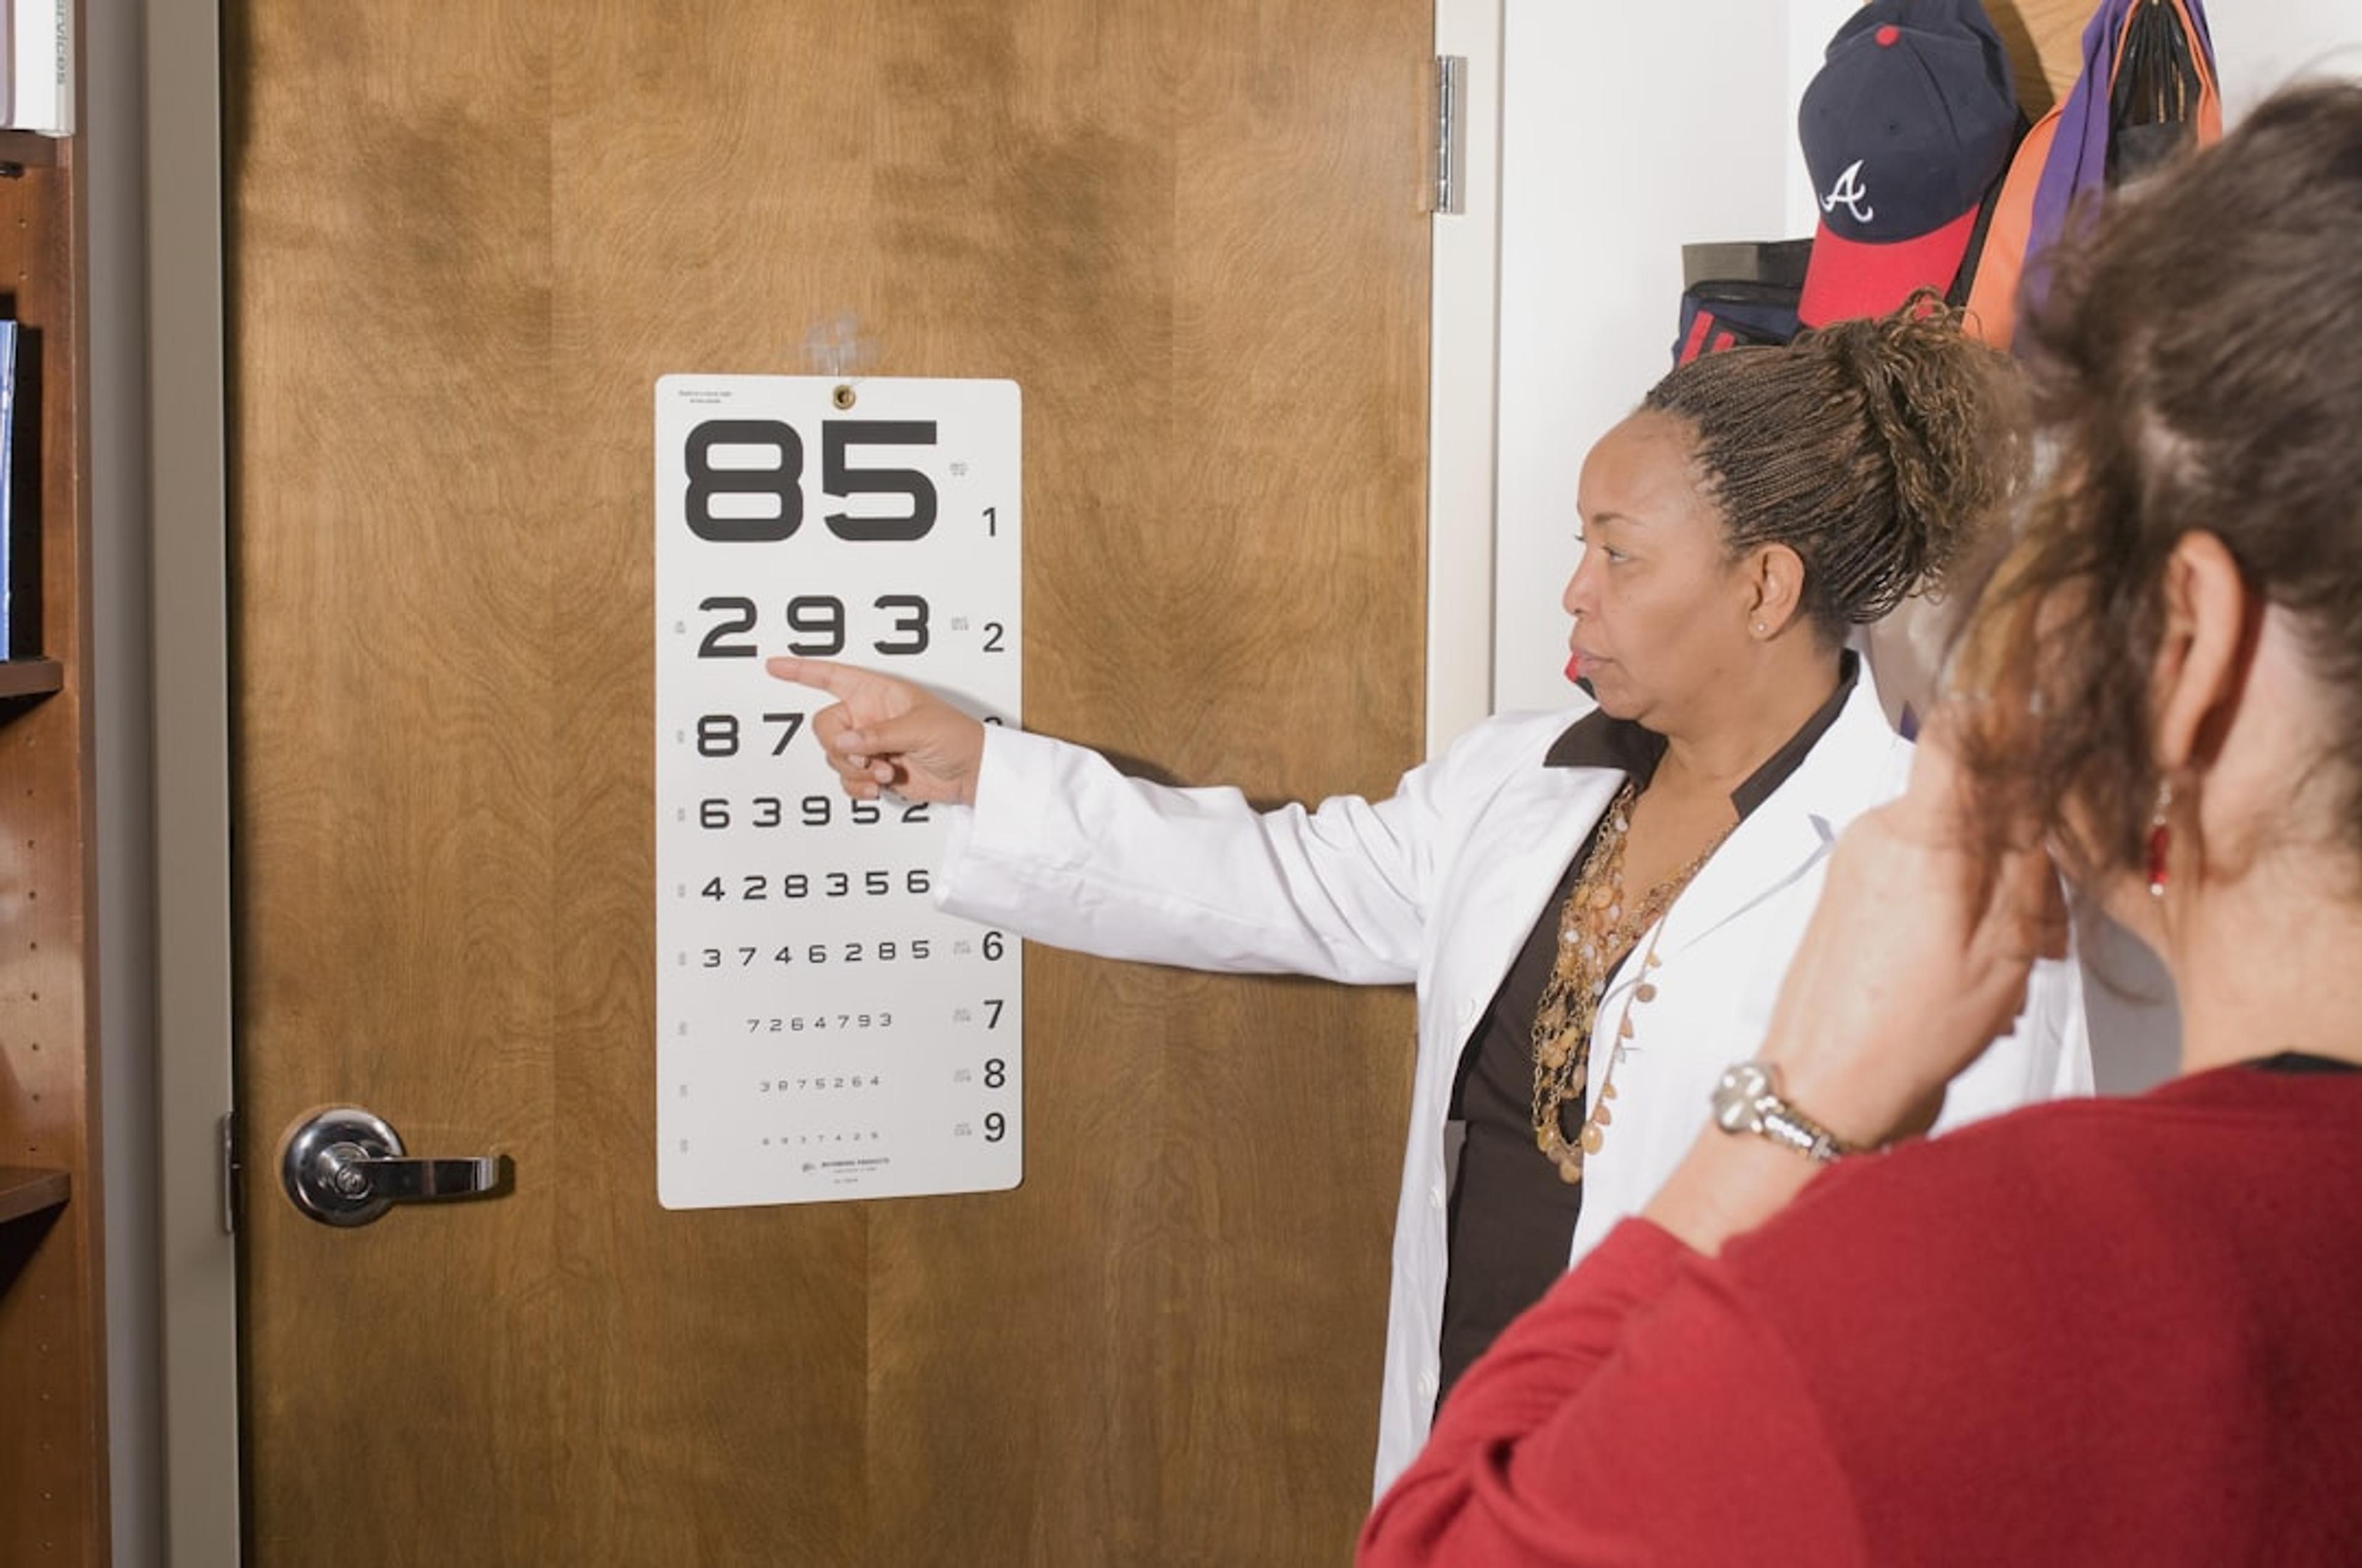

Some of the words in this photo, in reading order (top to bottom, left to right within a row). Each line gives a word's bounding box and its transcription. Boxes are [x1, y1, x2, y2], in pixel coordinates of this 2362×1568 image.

[1819, 159, 1874, 222] A
[684, 419, 939, 544] 85
[982, 507, 996, 537] 1
[698, 596, 758, 659] 2
[786, 594, 846, 657] 9
[873, 594, 931, 656] 3
[982, 622, 1005, 653] 2
[696, 714, 740, 758] 8
[762, 712, 805, 757] 7
[699, 797, 731, 830] 6
[752, 796, 782, 829] 3
[800, 795, 832, 827] 9
[701, 876, 726, 902] 4
[742, 875, 768, 901] 2
[784, 874, 809, 899] 8
[825, 872, 849, 898] 3
[864, 870, 889, 896] 5
[906, 869, 931, 894] 6
[982, 930, 1004, 961] 6
[983, 999, 1005, 1030] 7
[984, 1058, 1006, 1089] 8
[984, 1112, 1006, 1144] 9
